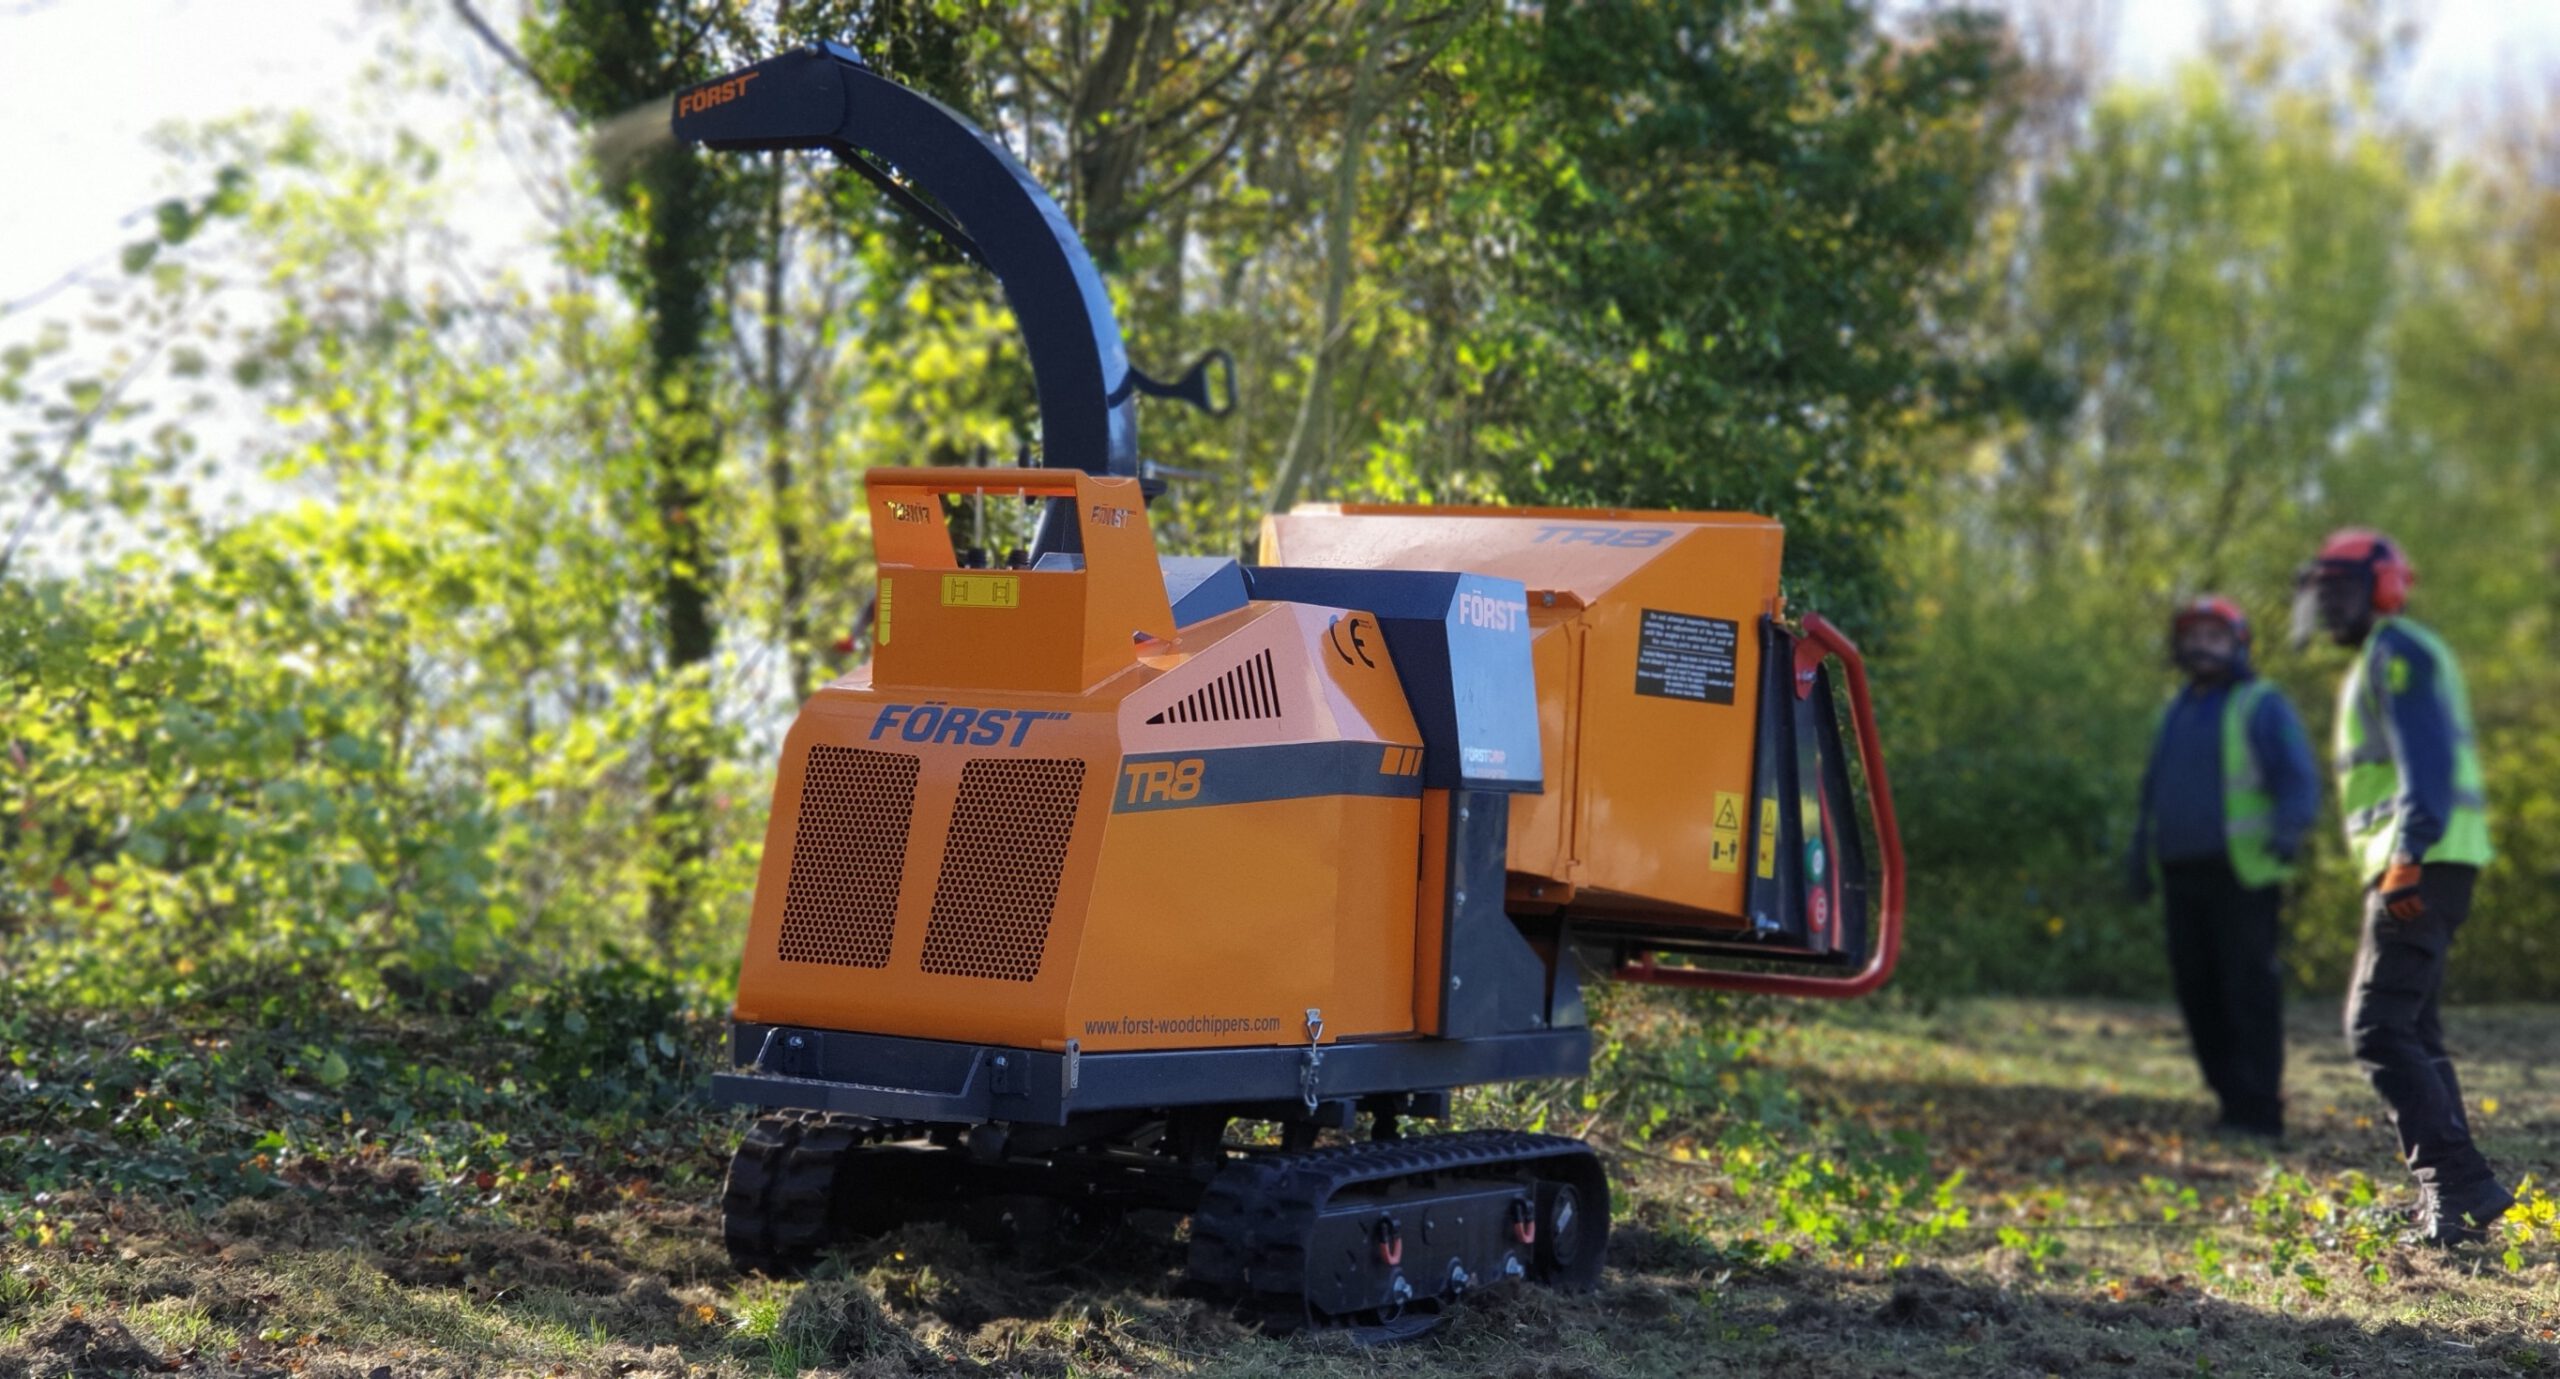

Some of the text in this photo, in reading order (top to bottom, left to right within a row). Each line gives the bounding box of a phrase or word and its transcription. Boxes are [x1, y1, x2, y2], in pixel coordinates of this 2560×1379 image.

[679, 71, 759, 118] FÖRST
[1531, 525, 1675, 548] TR8
[1459, 588, 1527, 633] FÖRST
[868, 702, 1071, 747] FÖRST
[1125, 758, 1205, 804] TR8
